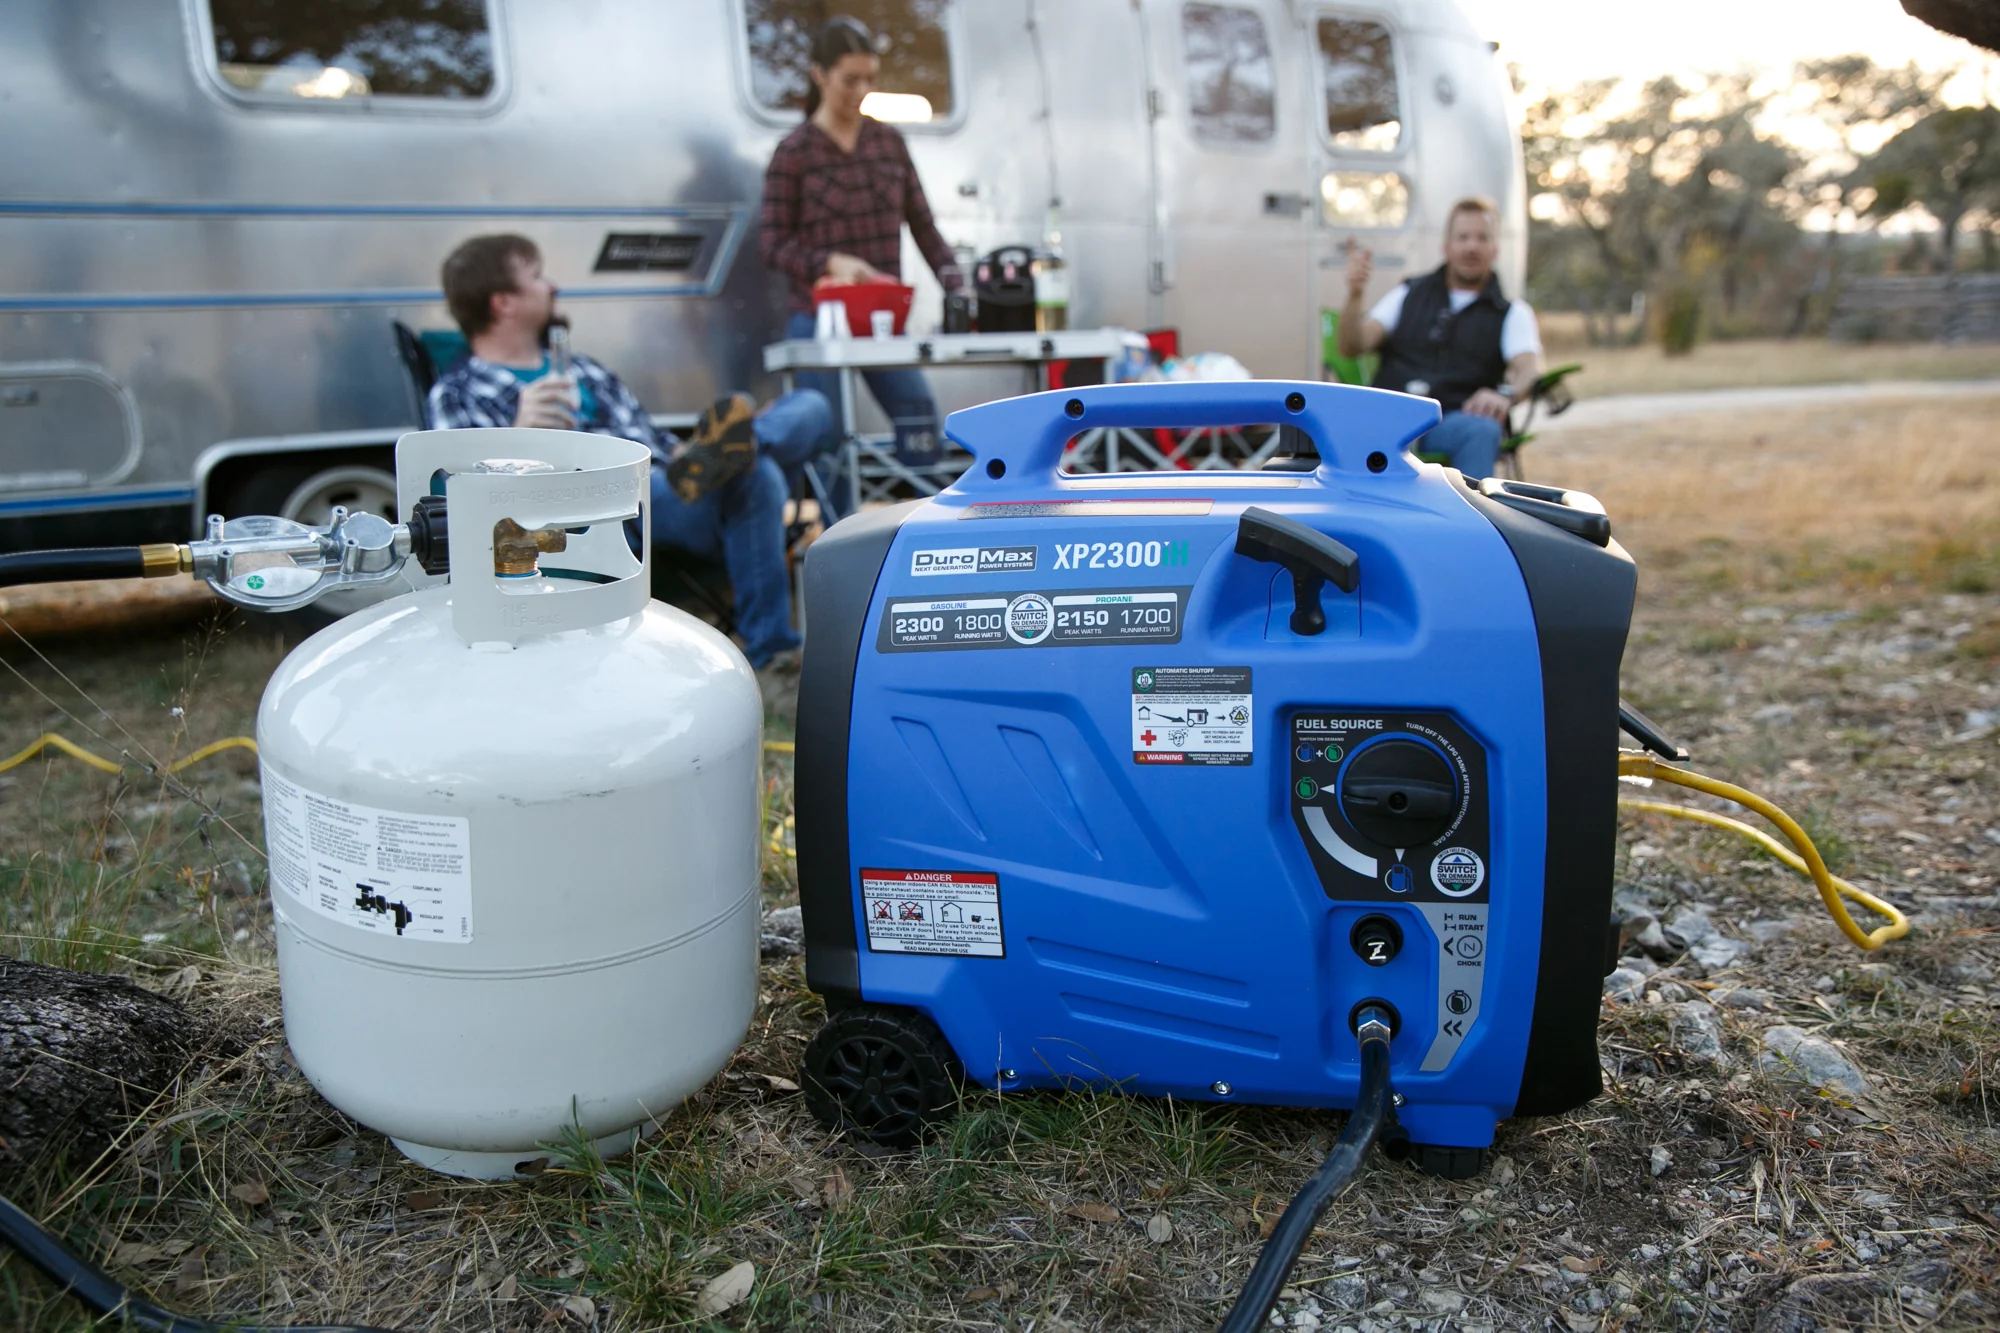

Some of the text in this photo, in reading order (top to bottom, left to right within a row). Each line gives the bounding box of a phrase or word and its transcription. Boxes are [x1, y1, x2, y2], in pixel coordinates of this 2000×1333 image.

[1053, 540, 1188, 570] XP2300iH
[930, 602, 967, 610] GASOLINE
[1011, 612, 1048, 620] SWITCH
[1057, 608, 1171, 627] 2150 1700
[895, 614, 1002, 633] 2300 1800
[1296, 719, 1383, 729] FUEL SOURCE
[1405, 721, 1470, 846] TURN OFF THE LPG TANK AFTER SWITCHING TO GAS
[1437, 865, 1478, 873] SWITCH
[913, 873, 952, 881] DANGER
